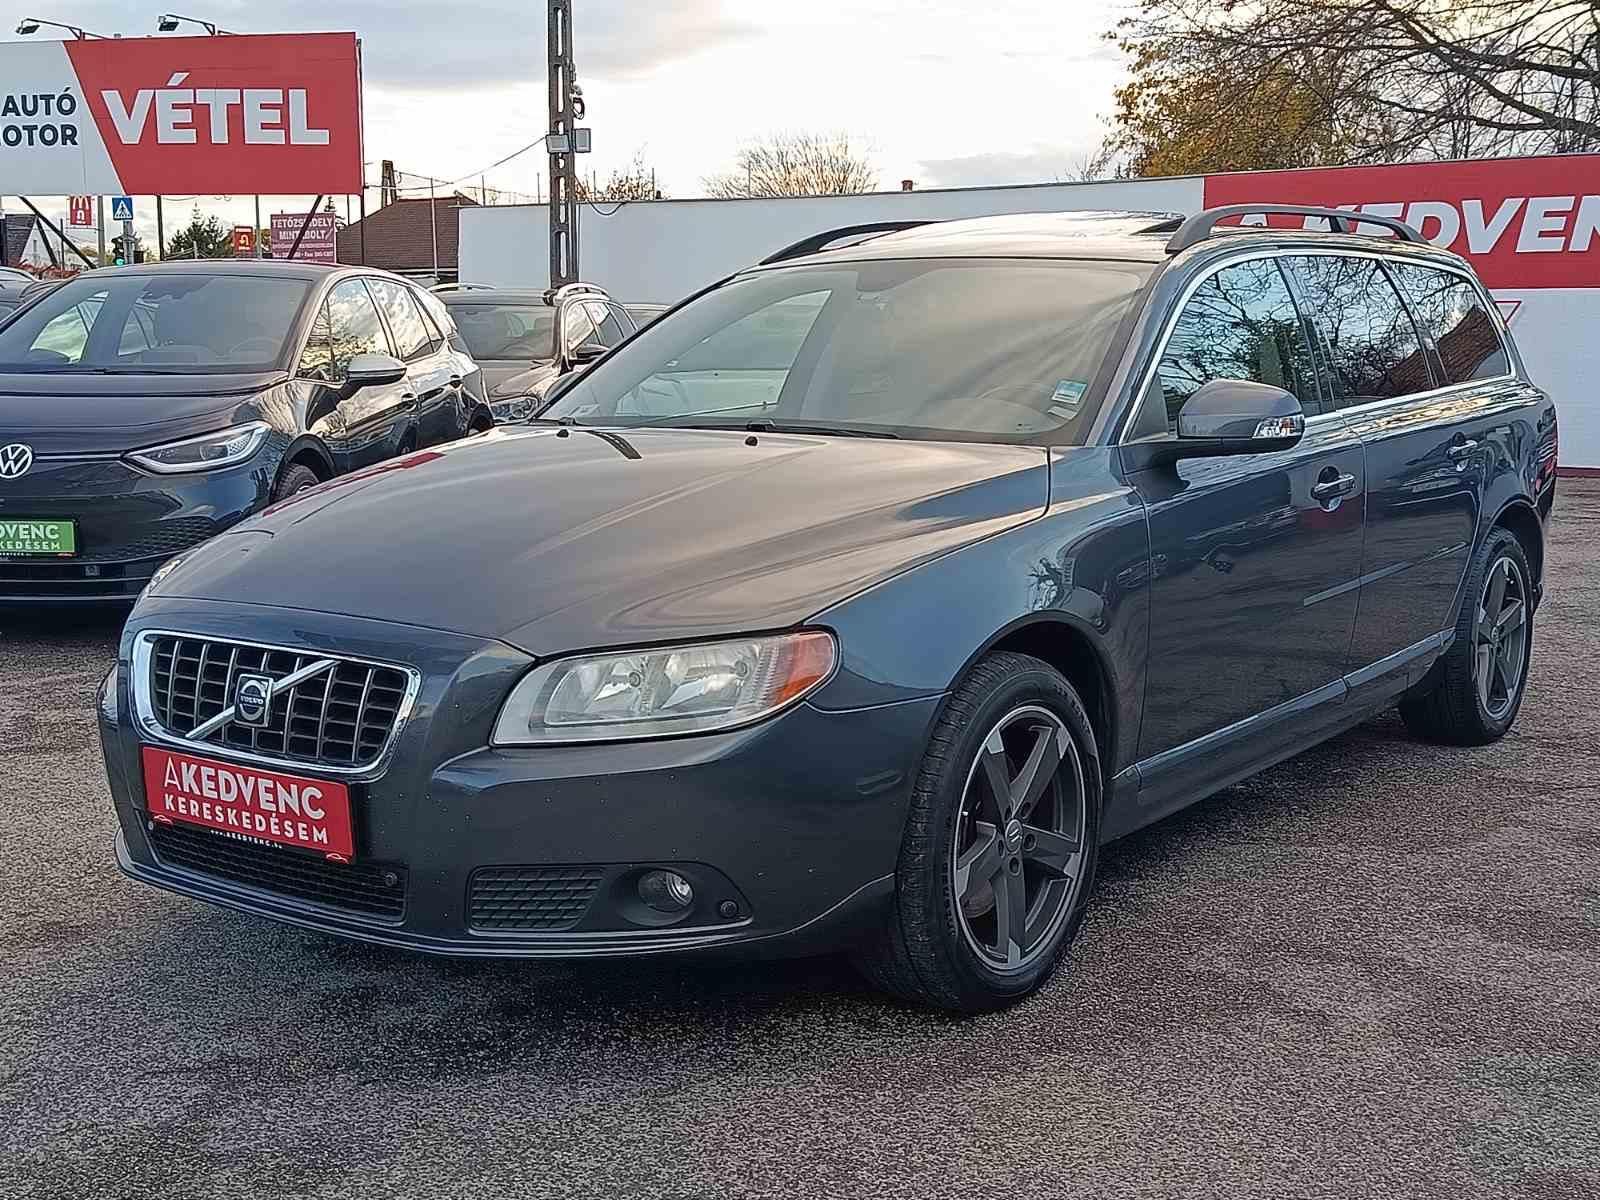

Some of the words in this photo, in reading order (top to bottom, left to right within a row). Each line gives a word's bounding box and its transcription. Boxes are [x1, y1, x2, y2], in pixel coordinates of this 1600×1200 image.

[1, 86, 77, 117] AUTÓ
[101, 72, 330, 144] VÉTEL
[0, 124, 78, 147] OTOR
[271, 216, 333, 228] TETŐZSDELY
[279, 230, 326, 240] MINTBOLT
[164, 756, 325, 820] AKEDVENC
[164, 793, 328, 845] KERESKEDÉSEM
